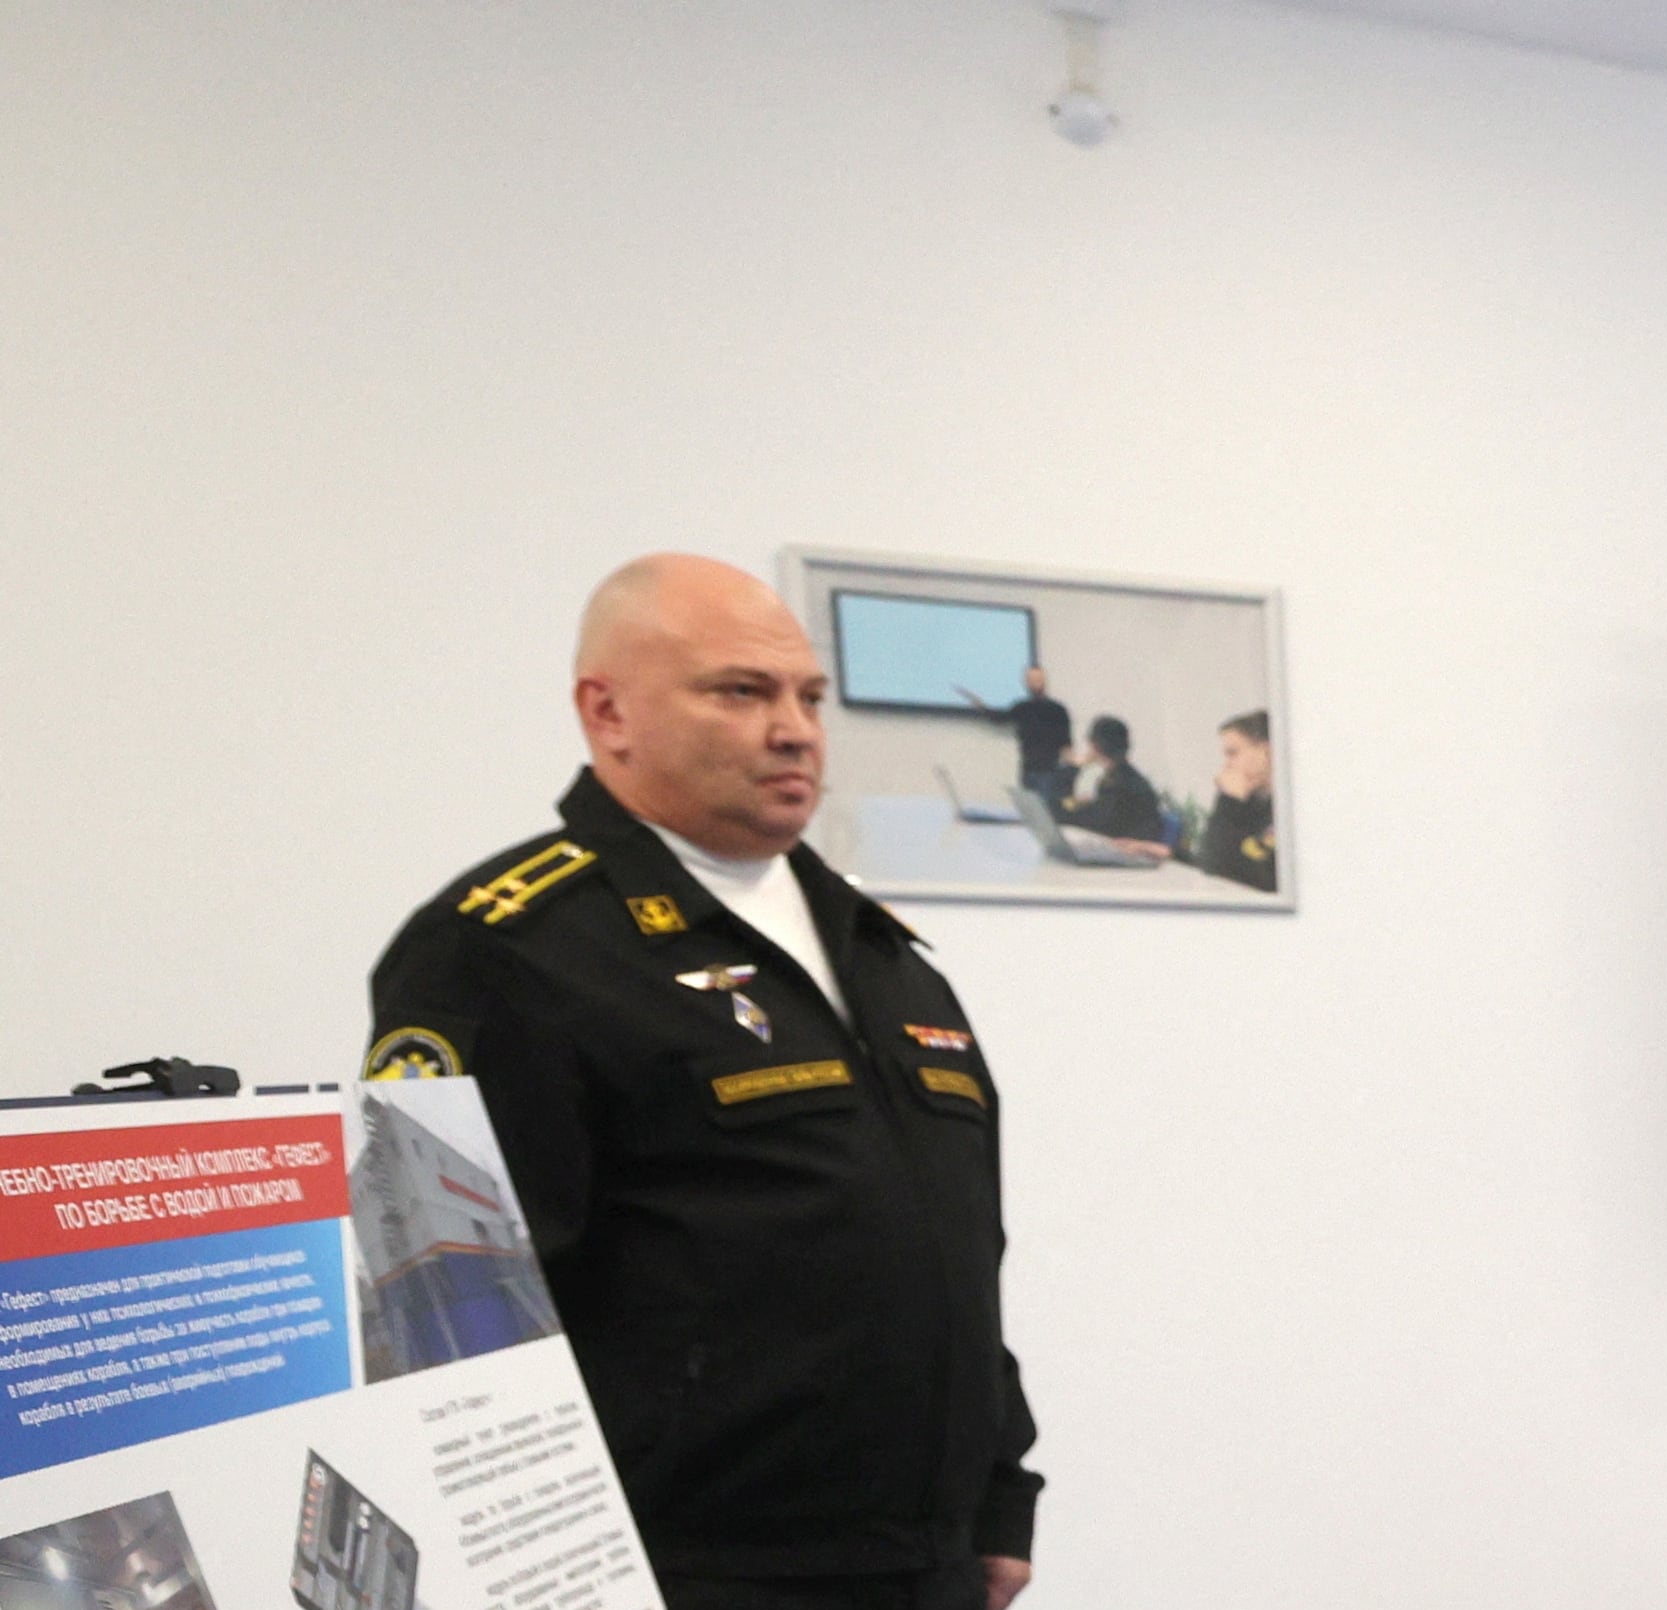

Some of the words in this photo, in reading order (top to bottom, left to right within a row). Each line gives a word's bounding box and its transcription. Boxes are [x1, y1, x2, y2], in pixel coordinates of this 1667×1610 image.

[193, 1146, 273, 1175] КОМПЛЕКС
[54, 1202, 85, 1229] ПО
[82, 1194, 152, 1226] БОРЬБЕ
[148, 1193, 167, 1218] С
[162, 1181, 219, 1218] ВОДОЙ
[216, 1185, 234, 1210] И
[230, 1178, 304, 1207] ПОЖАРОМ
